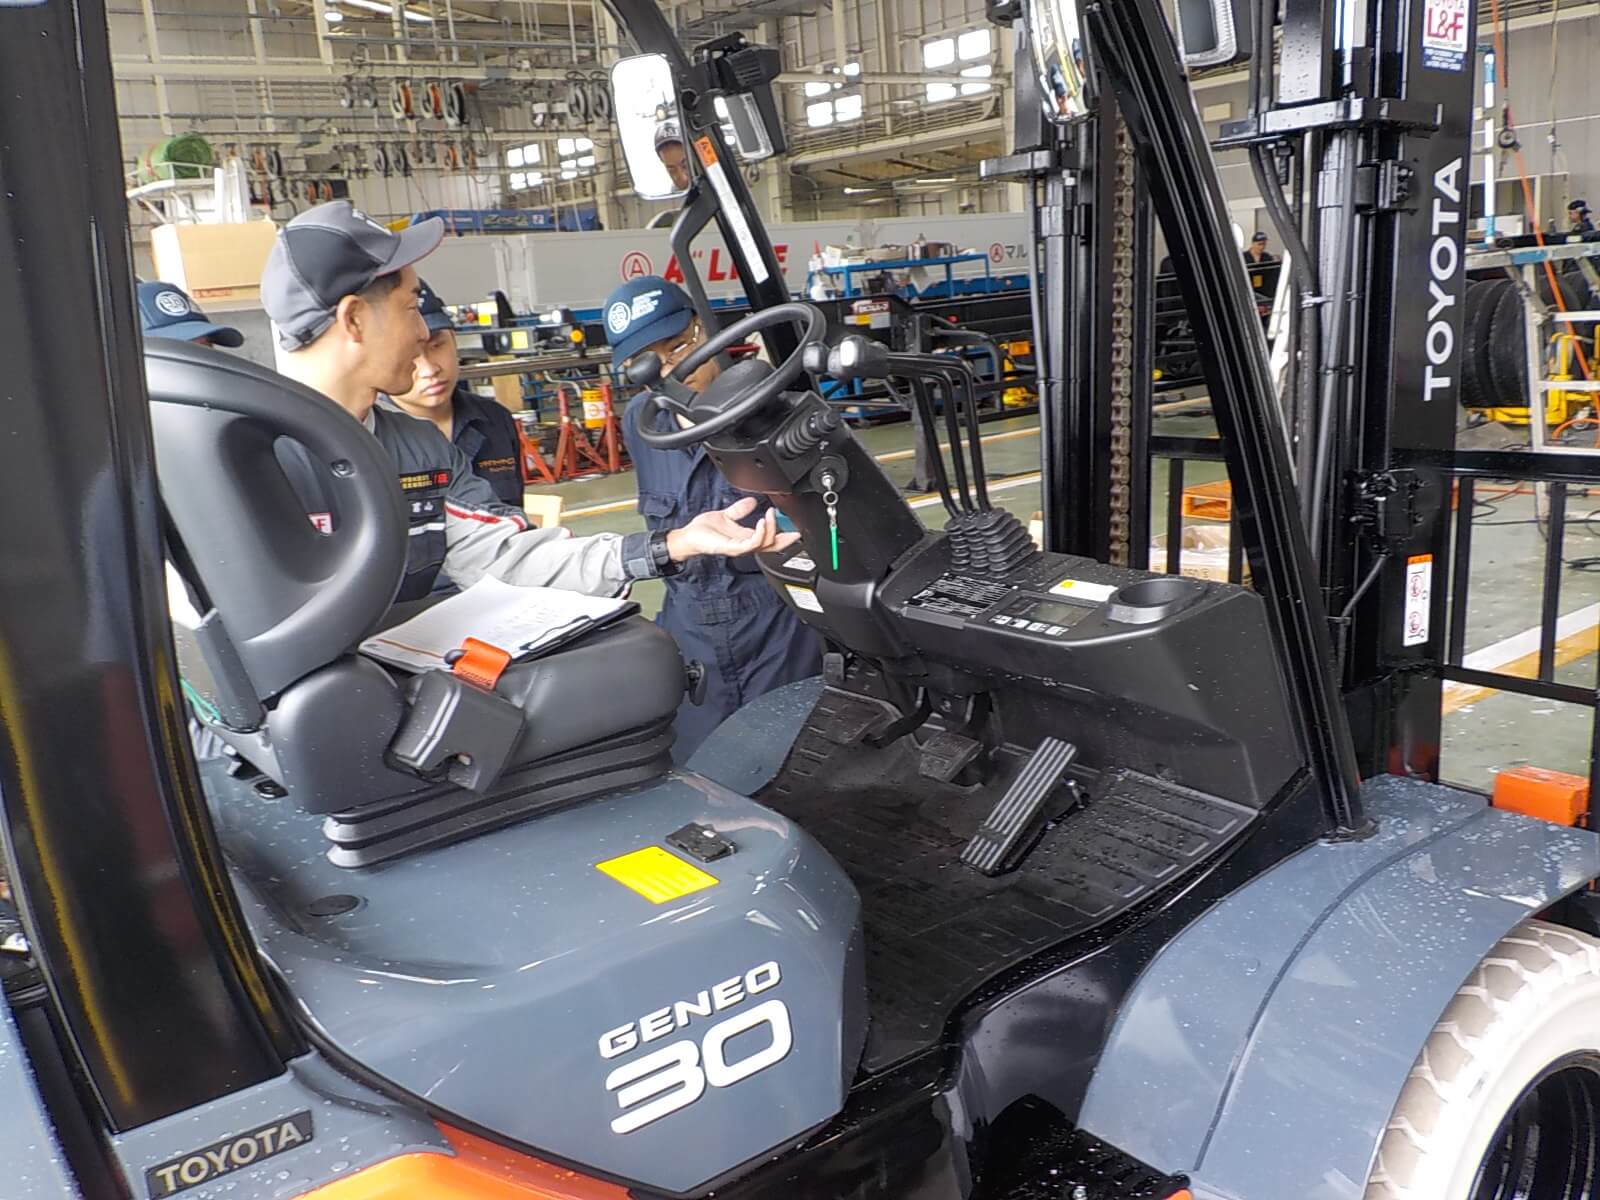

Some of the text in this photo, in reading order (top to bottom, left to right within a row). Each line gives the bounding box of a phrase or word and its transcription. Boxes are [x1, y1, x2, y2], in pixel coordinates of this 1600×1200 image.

[1426, 8, 1465, 41] L&F
[1423, 157, 1462, 402] TOYOTA
[598, 960, 781, 1059] GENEO
[605, 999, 792, 1135] 30
[155, 1121, 305, 1192] TOYOTA
